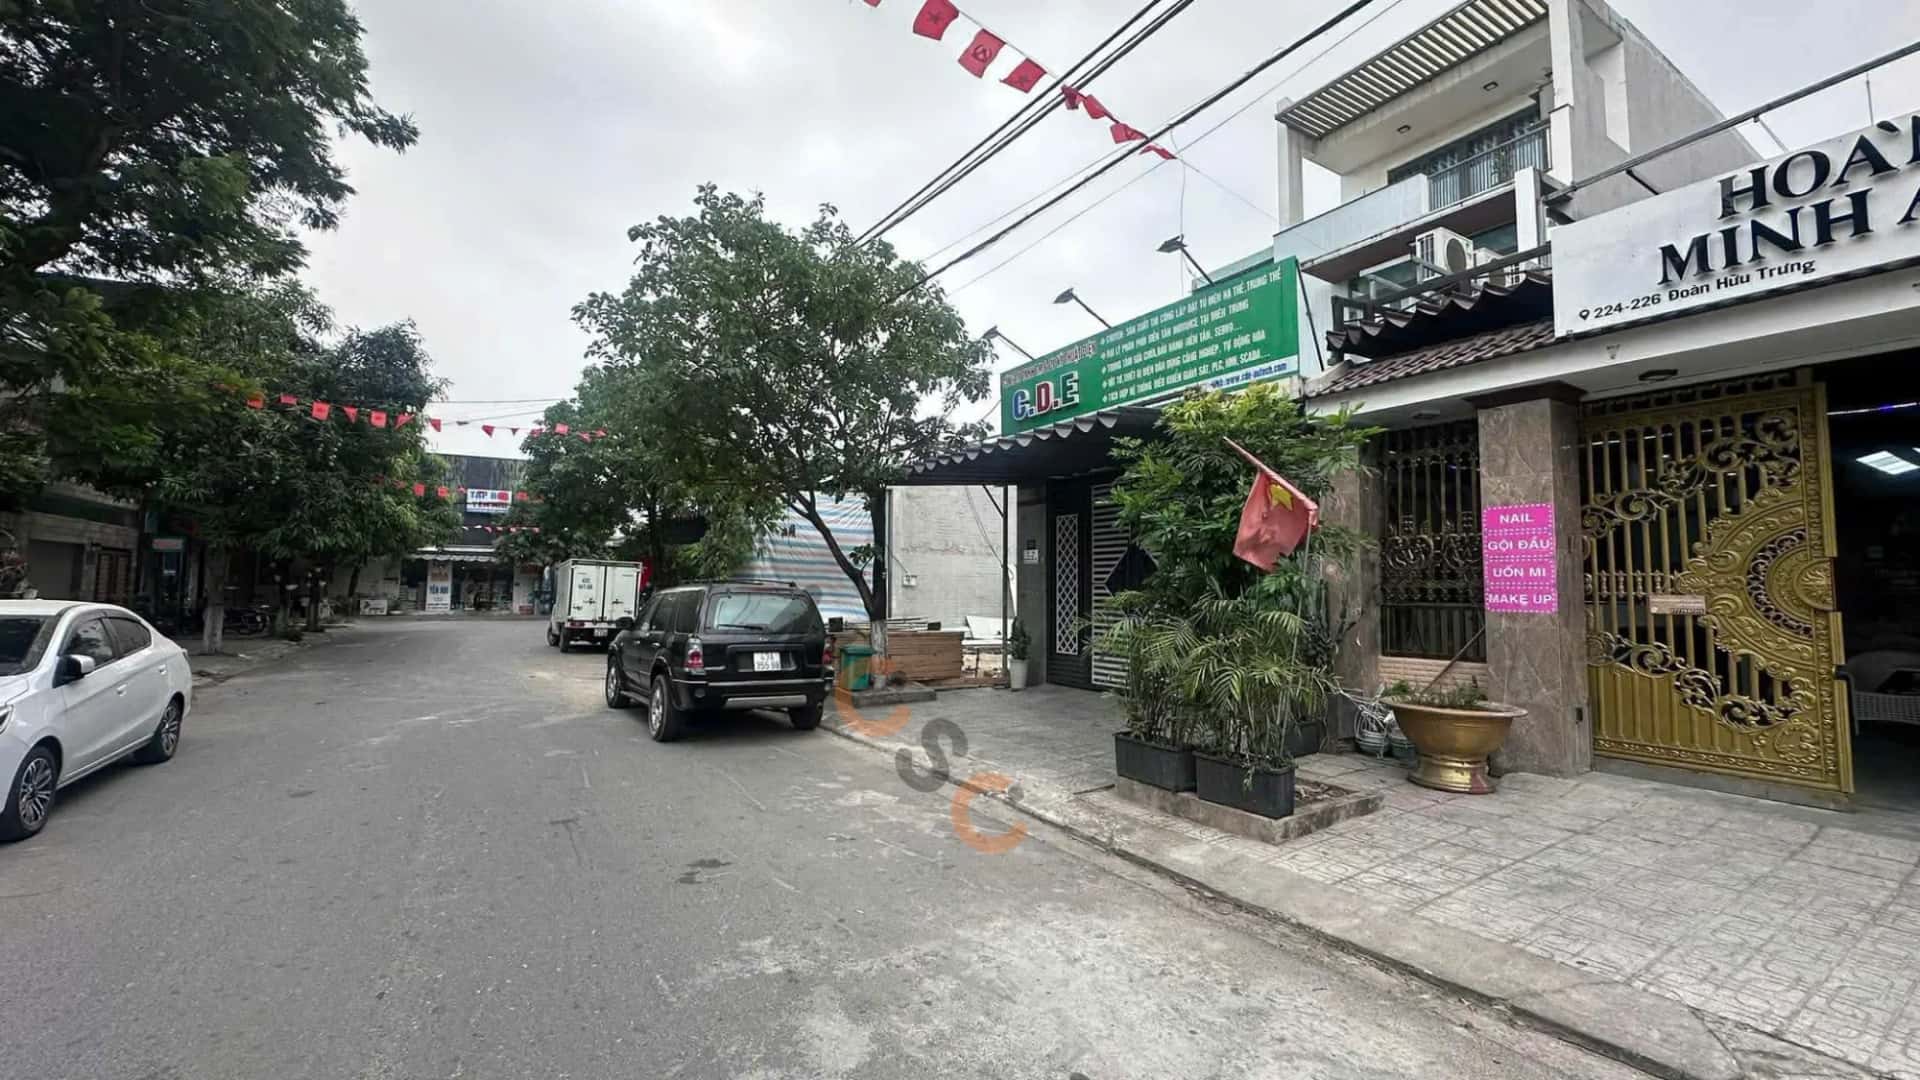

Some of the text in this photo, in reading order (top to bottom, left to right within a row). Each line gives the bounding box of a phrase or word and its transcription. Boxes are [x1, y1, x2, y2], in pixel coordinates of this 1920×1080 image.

[1657, 187, 1873, 285] MINH
[1593, 259, 1816, 319] 224-226 Đoàn Hữu Trưng
[1500, 513, 1534, 524] NAIL
[1529, 567, 1547, 577] MI
[1533, 594, 1553, 605] UP
